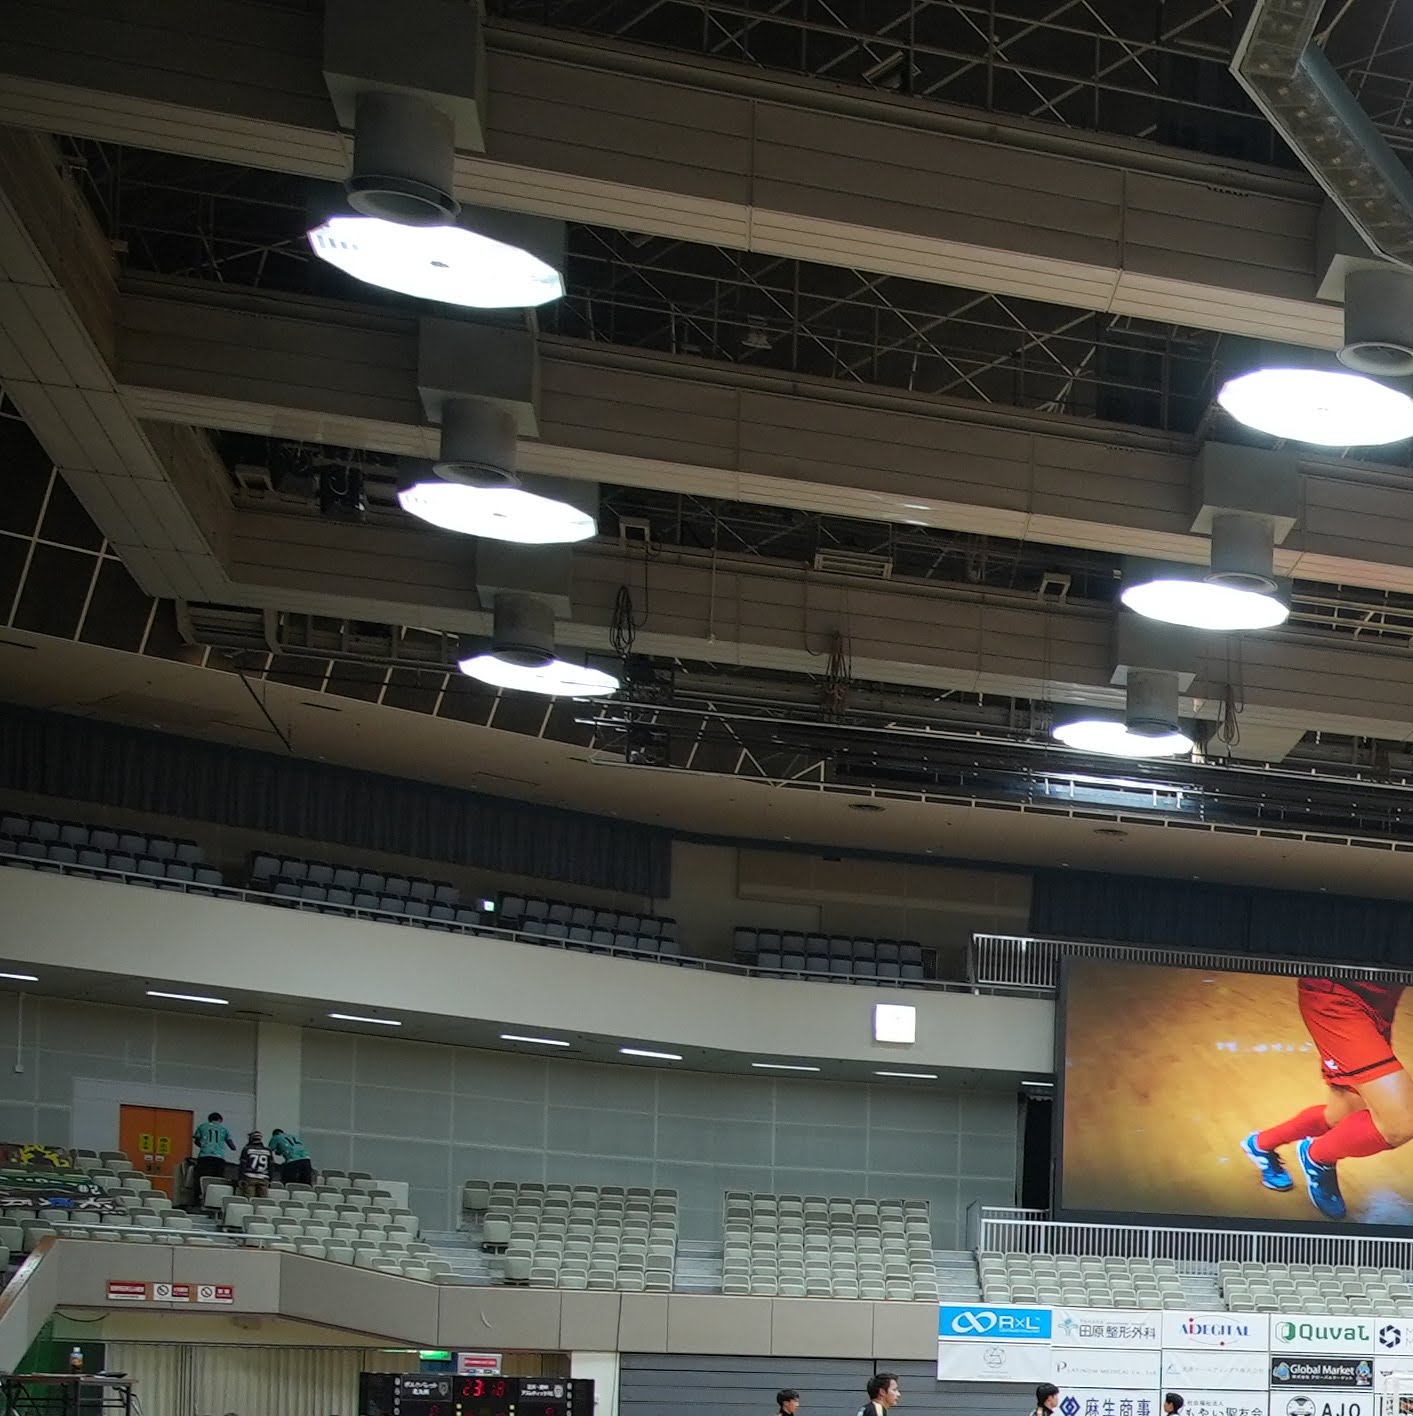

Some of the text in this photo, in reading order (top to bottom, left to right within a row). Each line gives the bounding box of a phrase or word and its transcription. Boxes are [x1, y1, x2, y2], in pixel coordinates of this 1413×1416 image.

[250, 1154, 269, 1170] 79
[1079, 1323, 1156, 1340] 田原整形外科
[1290, 1364, 1355, 1376] Global Market
